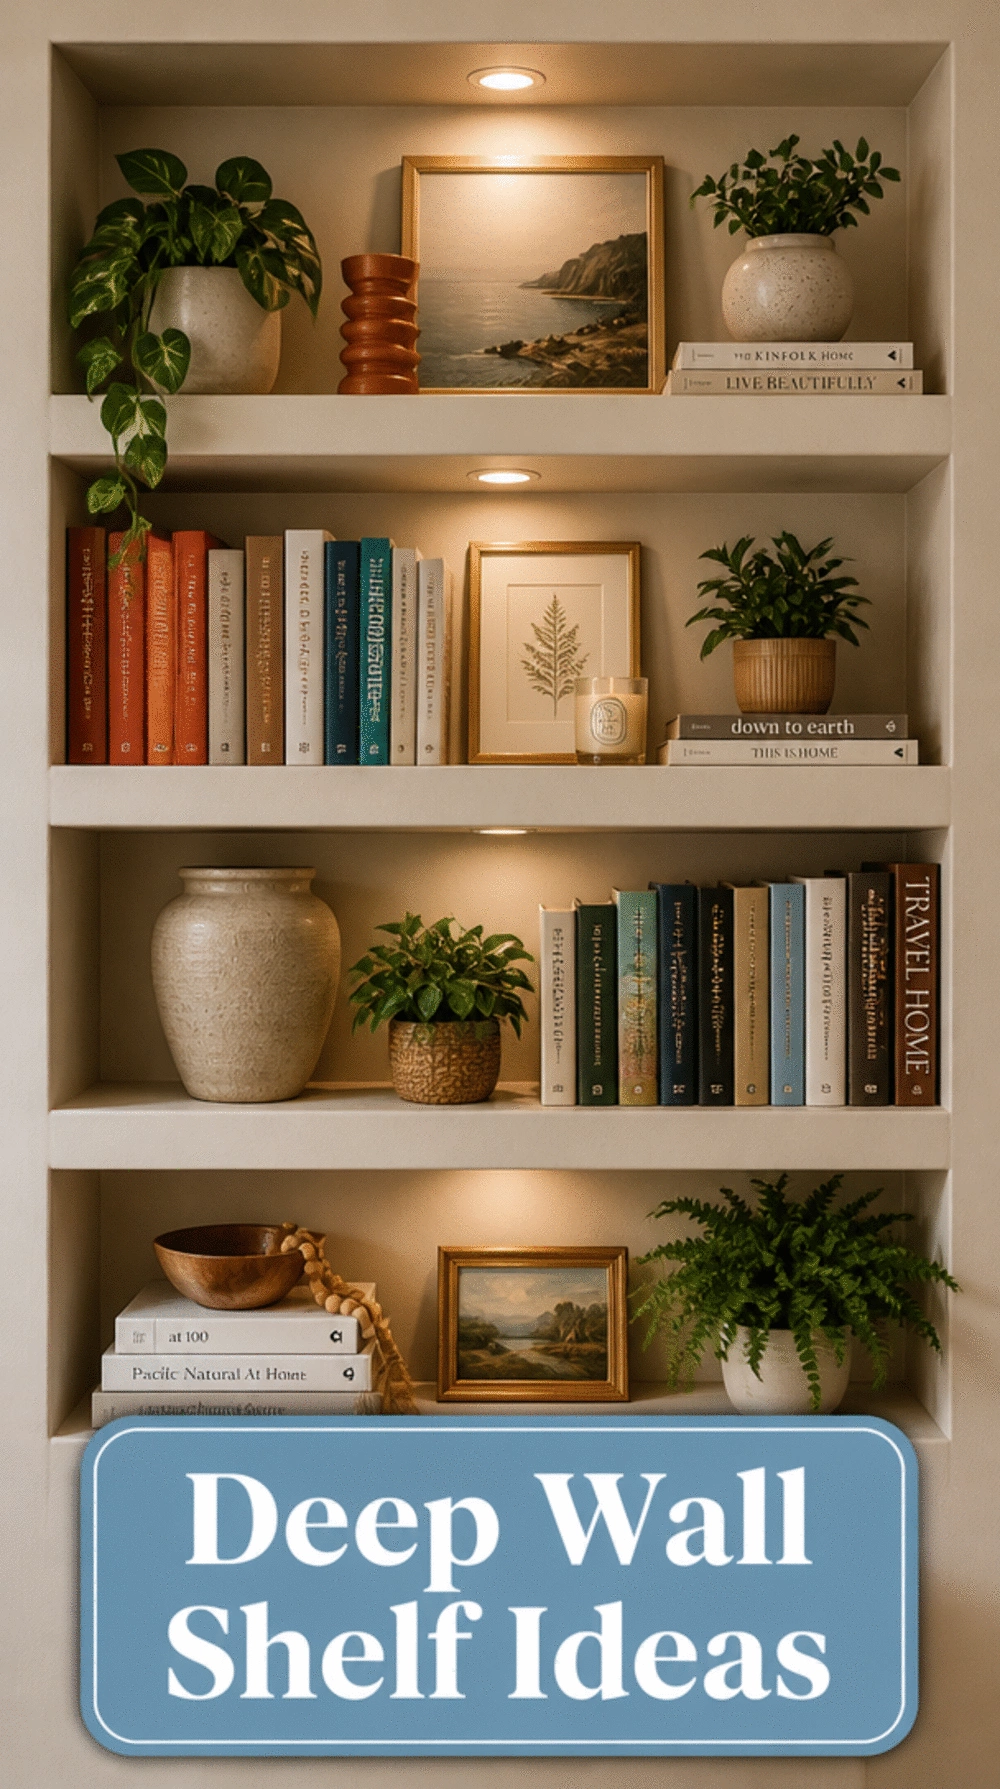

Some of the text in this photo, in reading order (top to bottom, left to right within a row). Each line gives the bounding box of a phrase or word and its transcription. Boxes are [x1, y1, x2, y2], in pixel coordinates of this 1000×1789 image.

[726, 376, 763, 390] LIVE
[766, 376, 877, 390] BEAUTIFULLY
[731, 718, 779, 735] down
[785, 720, 802, 735] to
[807, 719, 855, 735] earth
[752, 747, 839, 759] THIS IS HOME
[904, 876, 931, 1075] TRAVEL HOME
[168, 1330, 209, 1343] at 100
